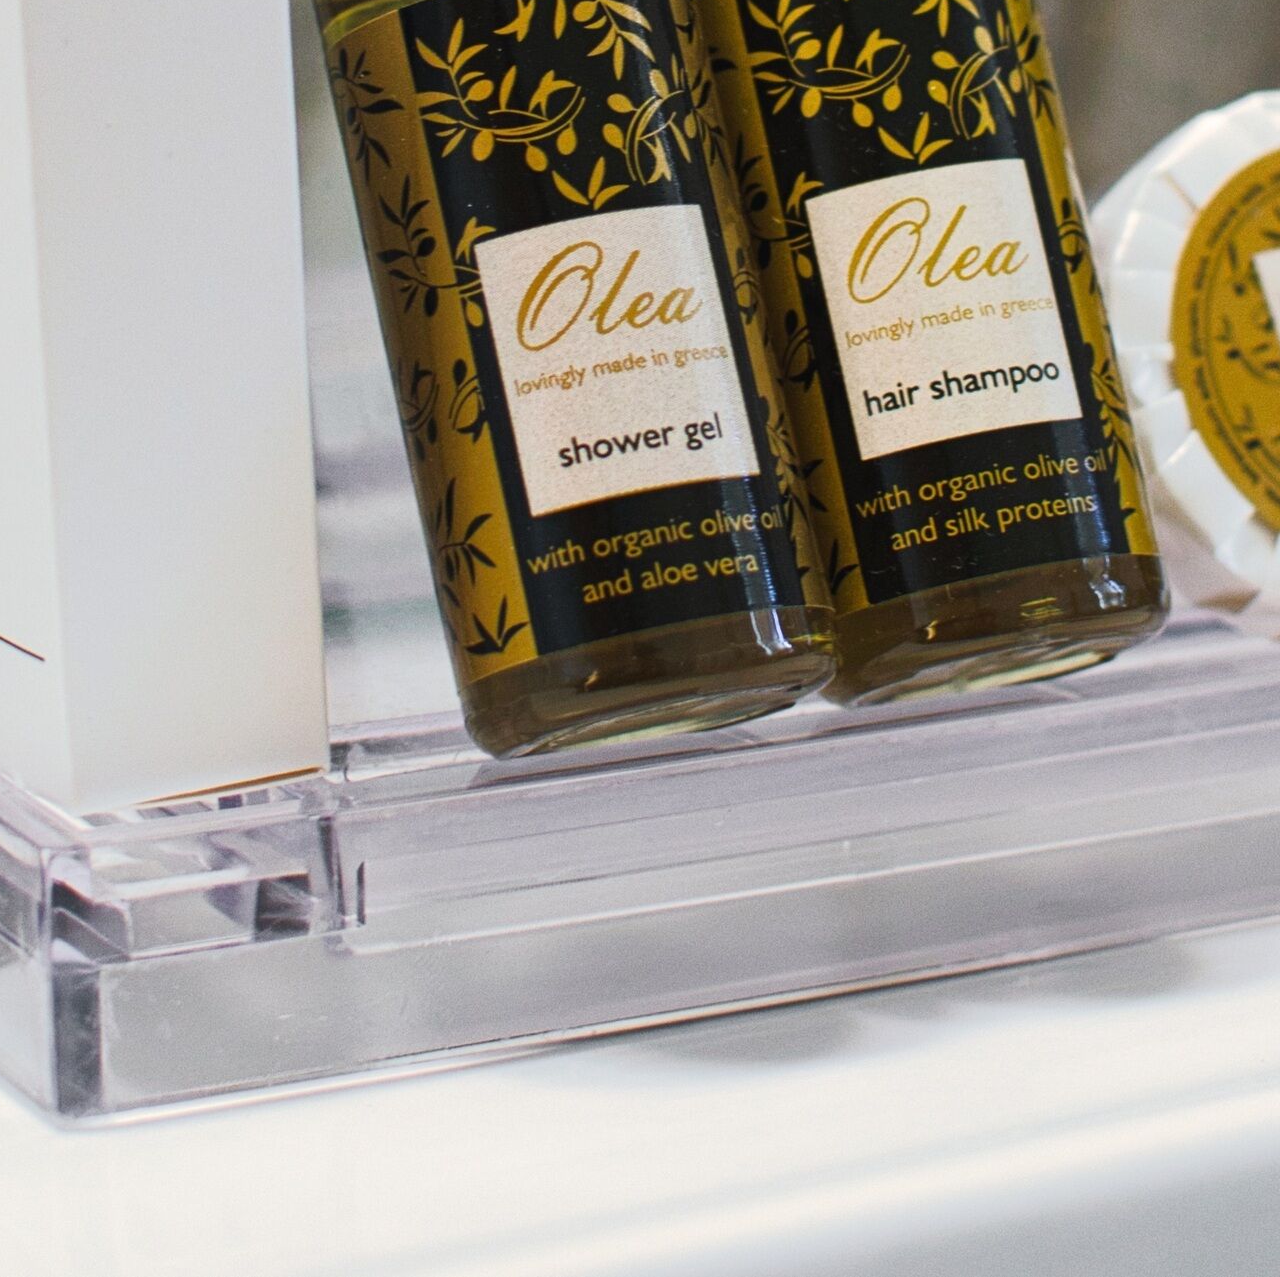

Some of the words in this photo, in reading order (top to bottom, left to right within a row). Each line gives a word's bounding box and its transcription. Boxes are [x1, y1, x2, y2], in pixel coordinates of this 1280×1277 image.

[847, 196, 1030, 304] Olea
[517, 240, 704, 352] Olea
[845, 316, 915, 349] lovingly
[920, 304, 974, 329] made
[979, 300, 997, 317] in
[1001, 295, 1055, 320] greece
[514, 365, 586, 397] lovingly
[592, 352, 647, 377] made
[650, 348, 669, 367] in
[674, 344, 730, 369] greece
[863, 381, 921, 417] hair
[928, 362, 1060, 401] shampoo
[558, 425, 674, 468] shower
[684, 411, 724, 451] gel
[856, 483, 912, 519] with
[918, 462, 1018, 502] organic
[1023, 452, 1080, 481] olive
[1084, 447, 1108, 473] oil
[527, 537, 586, 575] with
[592, 518, 695, 559] organic
[700, 508, 757, 537] olive
[760, 502, 785, 530] oil
[890, 516, 938, 552] and
[945, 505, 991, 538] silk
[996, 491, 1099, 534] proteins
[582, 568, 634, 604] and
[641, 561, 699, 591] aloe
[704, 552, 760, 577] vera
